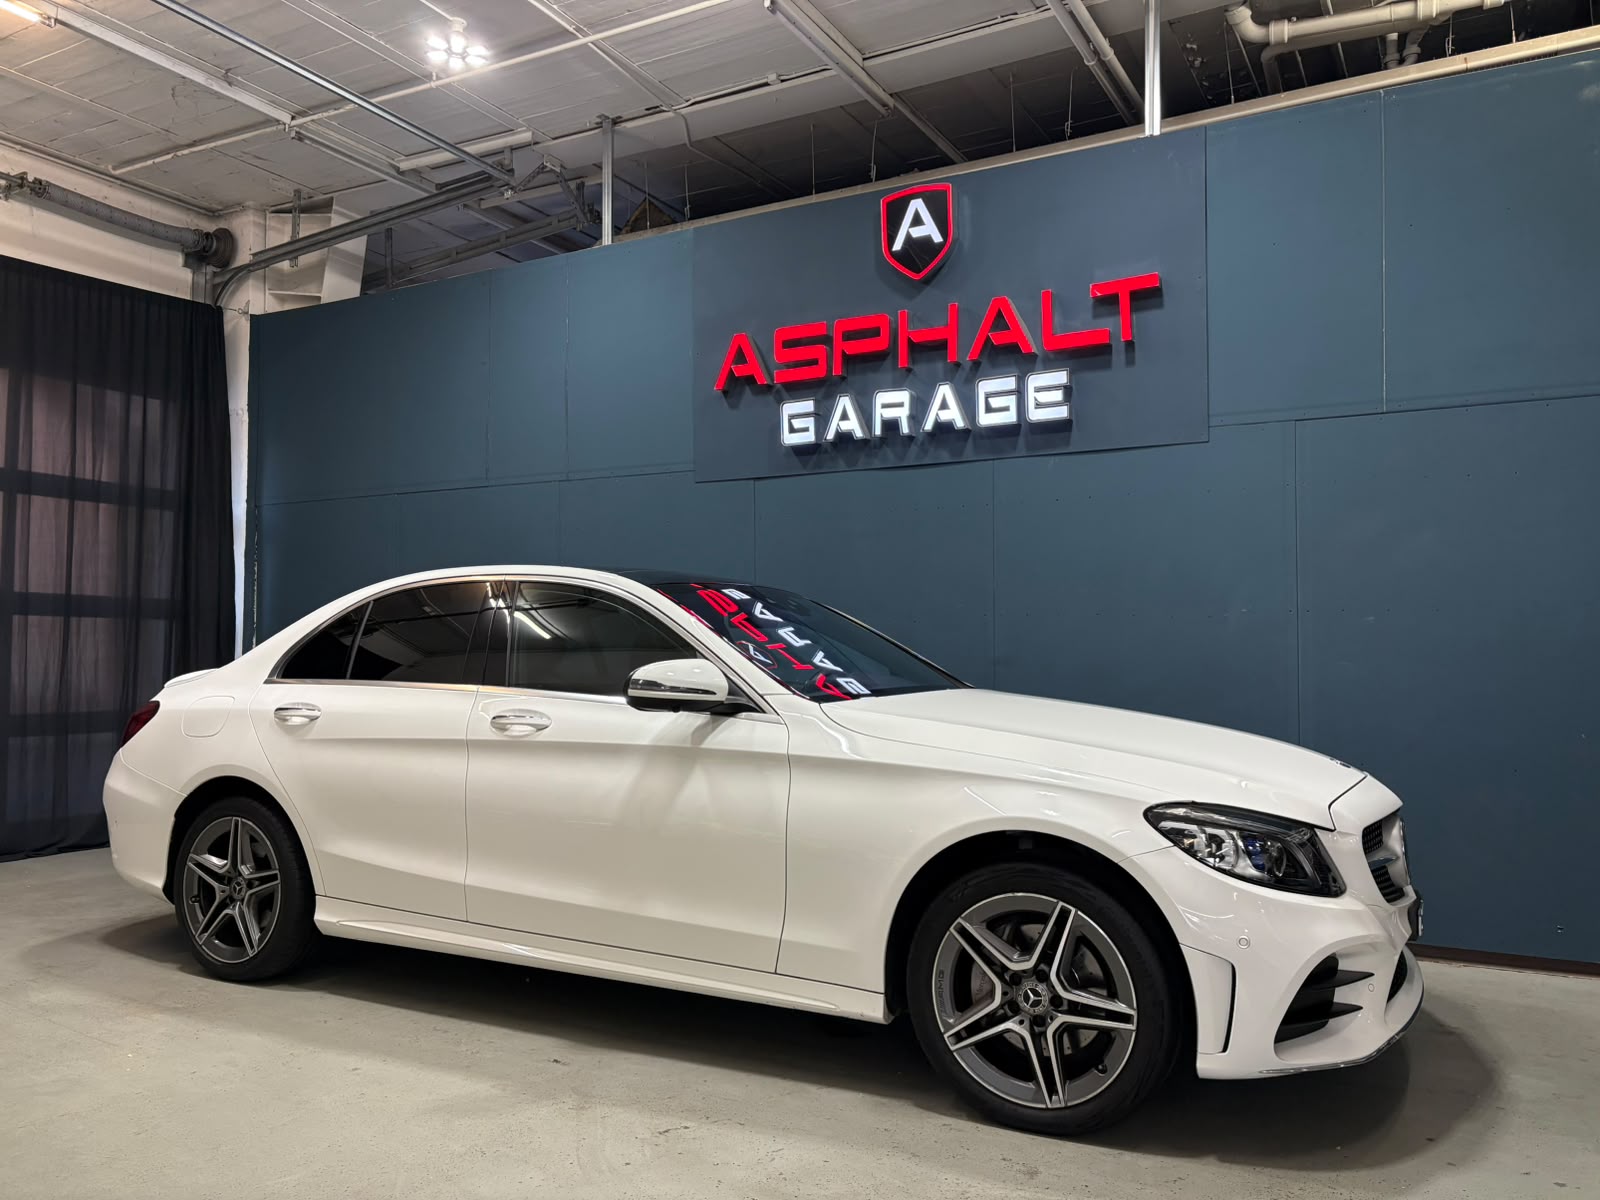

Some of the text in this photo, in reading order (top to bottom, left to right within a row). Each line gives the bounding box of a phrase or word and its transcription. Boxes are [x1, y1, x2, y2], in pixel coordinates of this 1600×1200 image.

[892, 198, 944, 251] A
[714, 272, 1161, 392] ASPHALT
[779, 368, 1071, 447] GARAGE
